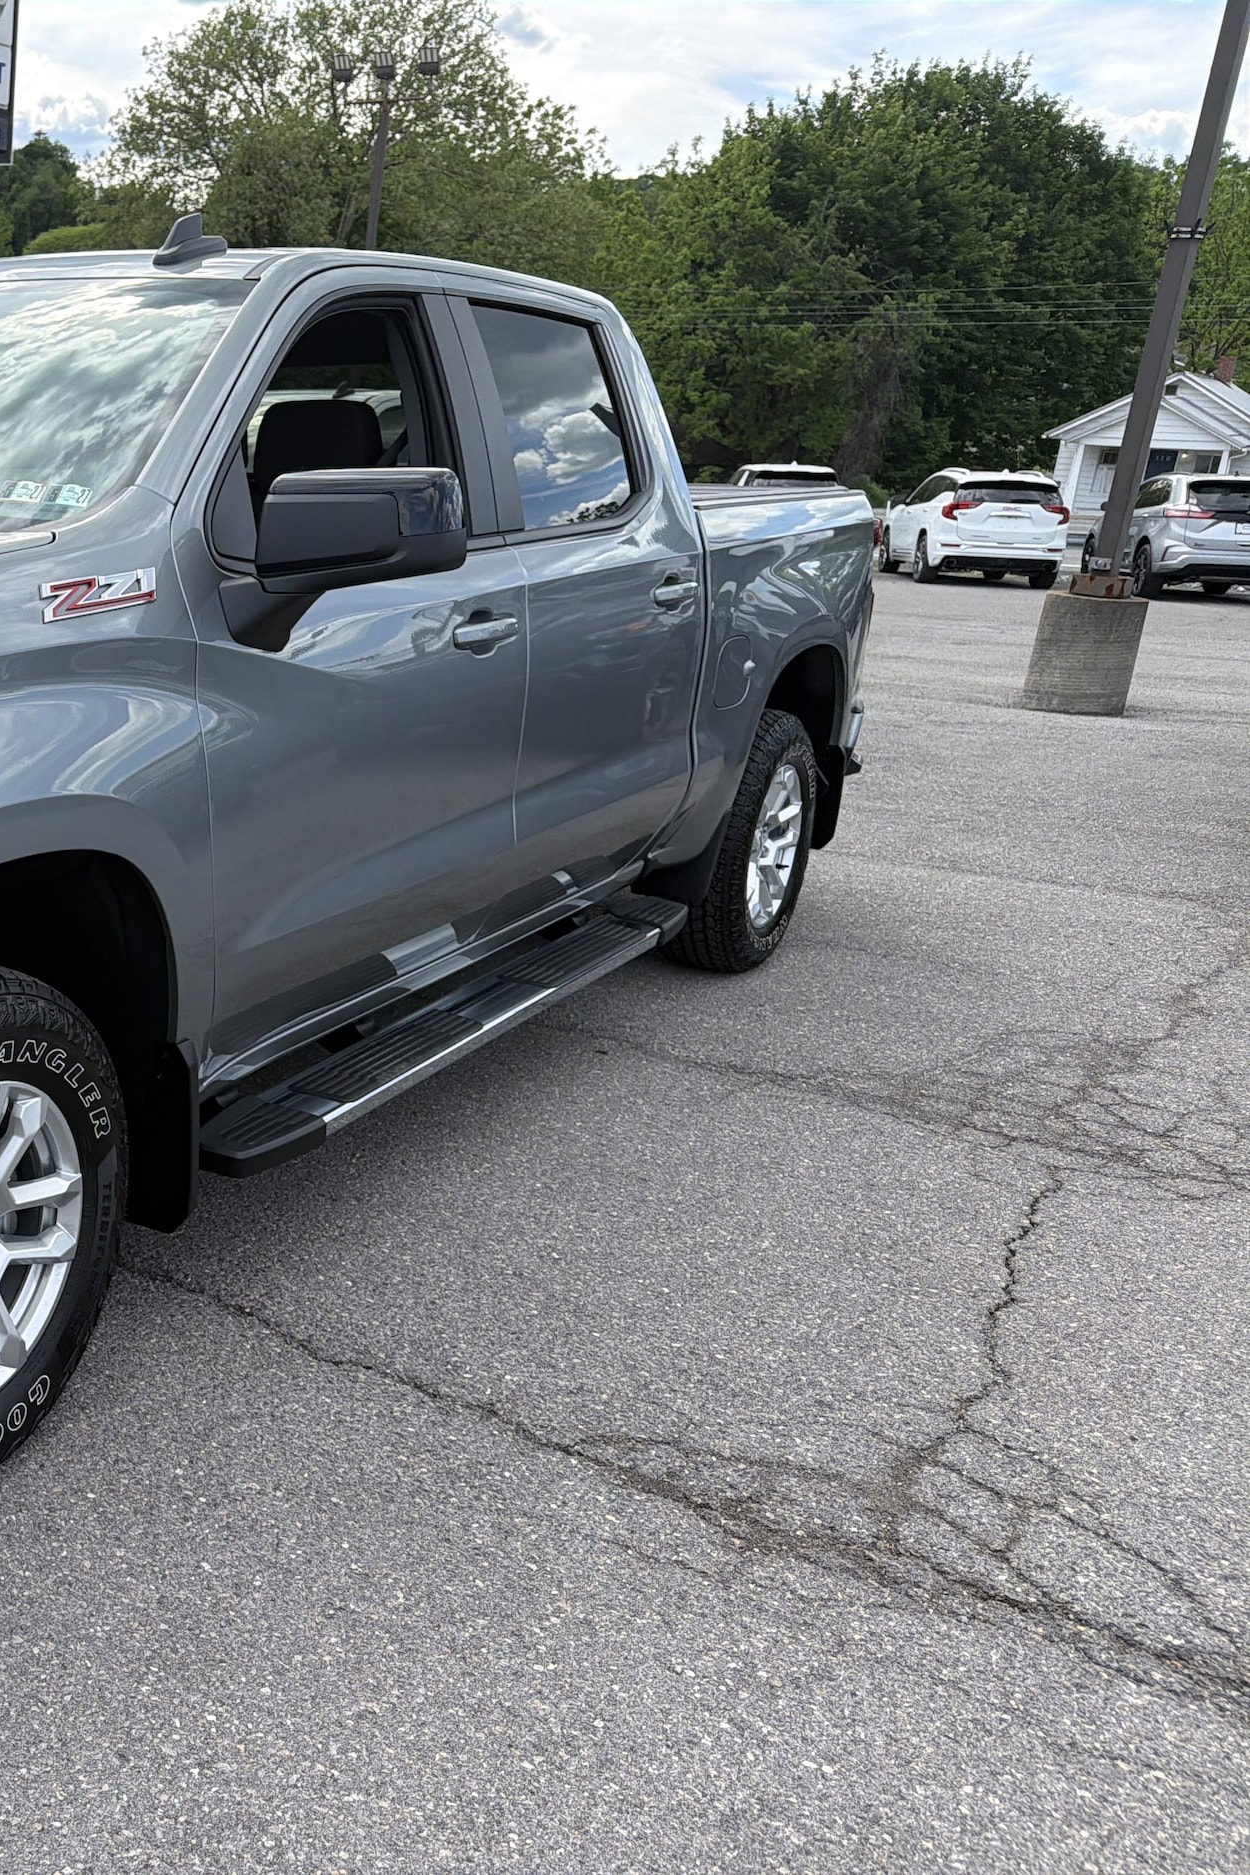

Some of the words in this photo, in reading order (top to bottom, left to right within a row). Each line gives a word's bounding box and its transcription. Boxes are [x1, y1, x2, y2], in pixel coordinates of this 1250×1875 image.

[29, 485, 46, 500] 27
[49, 488, 60, 502] 5
[76, 489, 92, 504] 27
[39, 567, 156, 623] Z71
